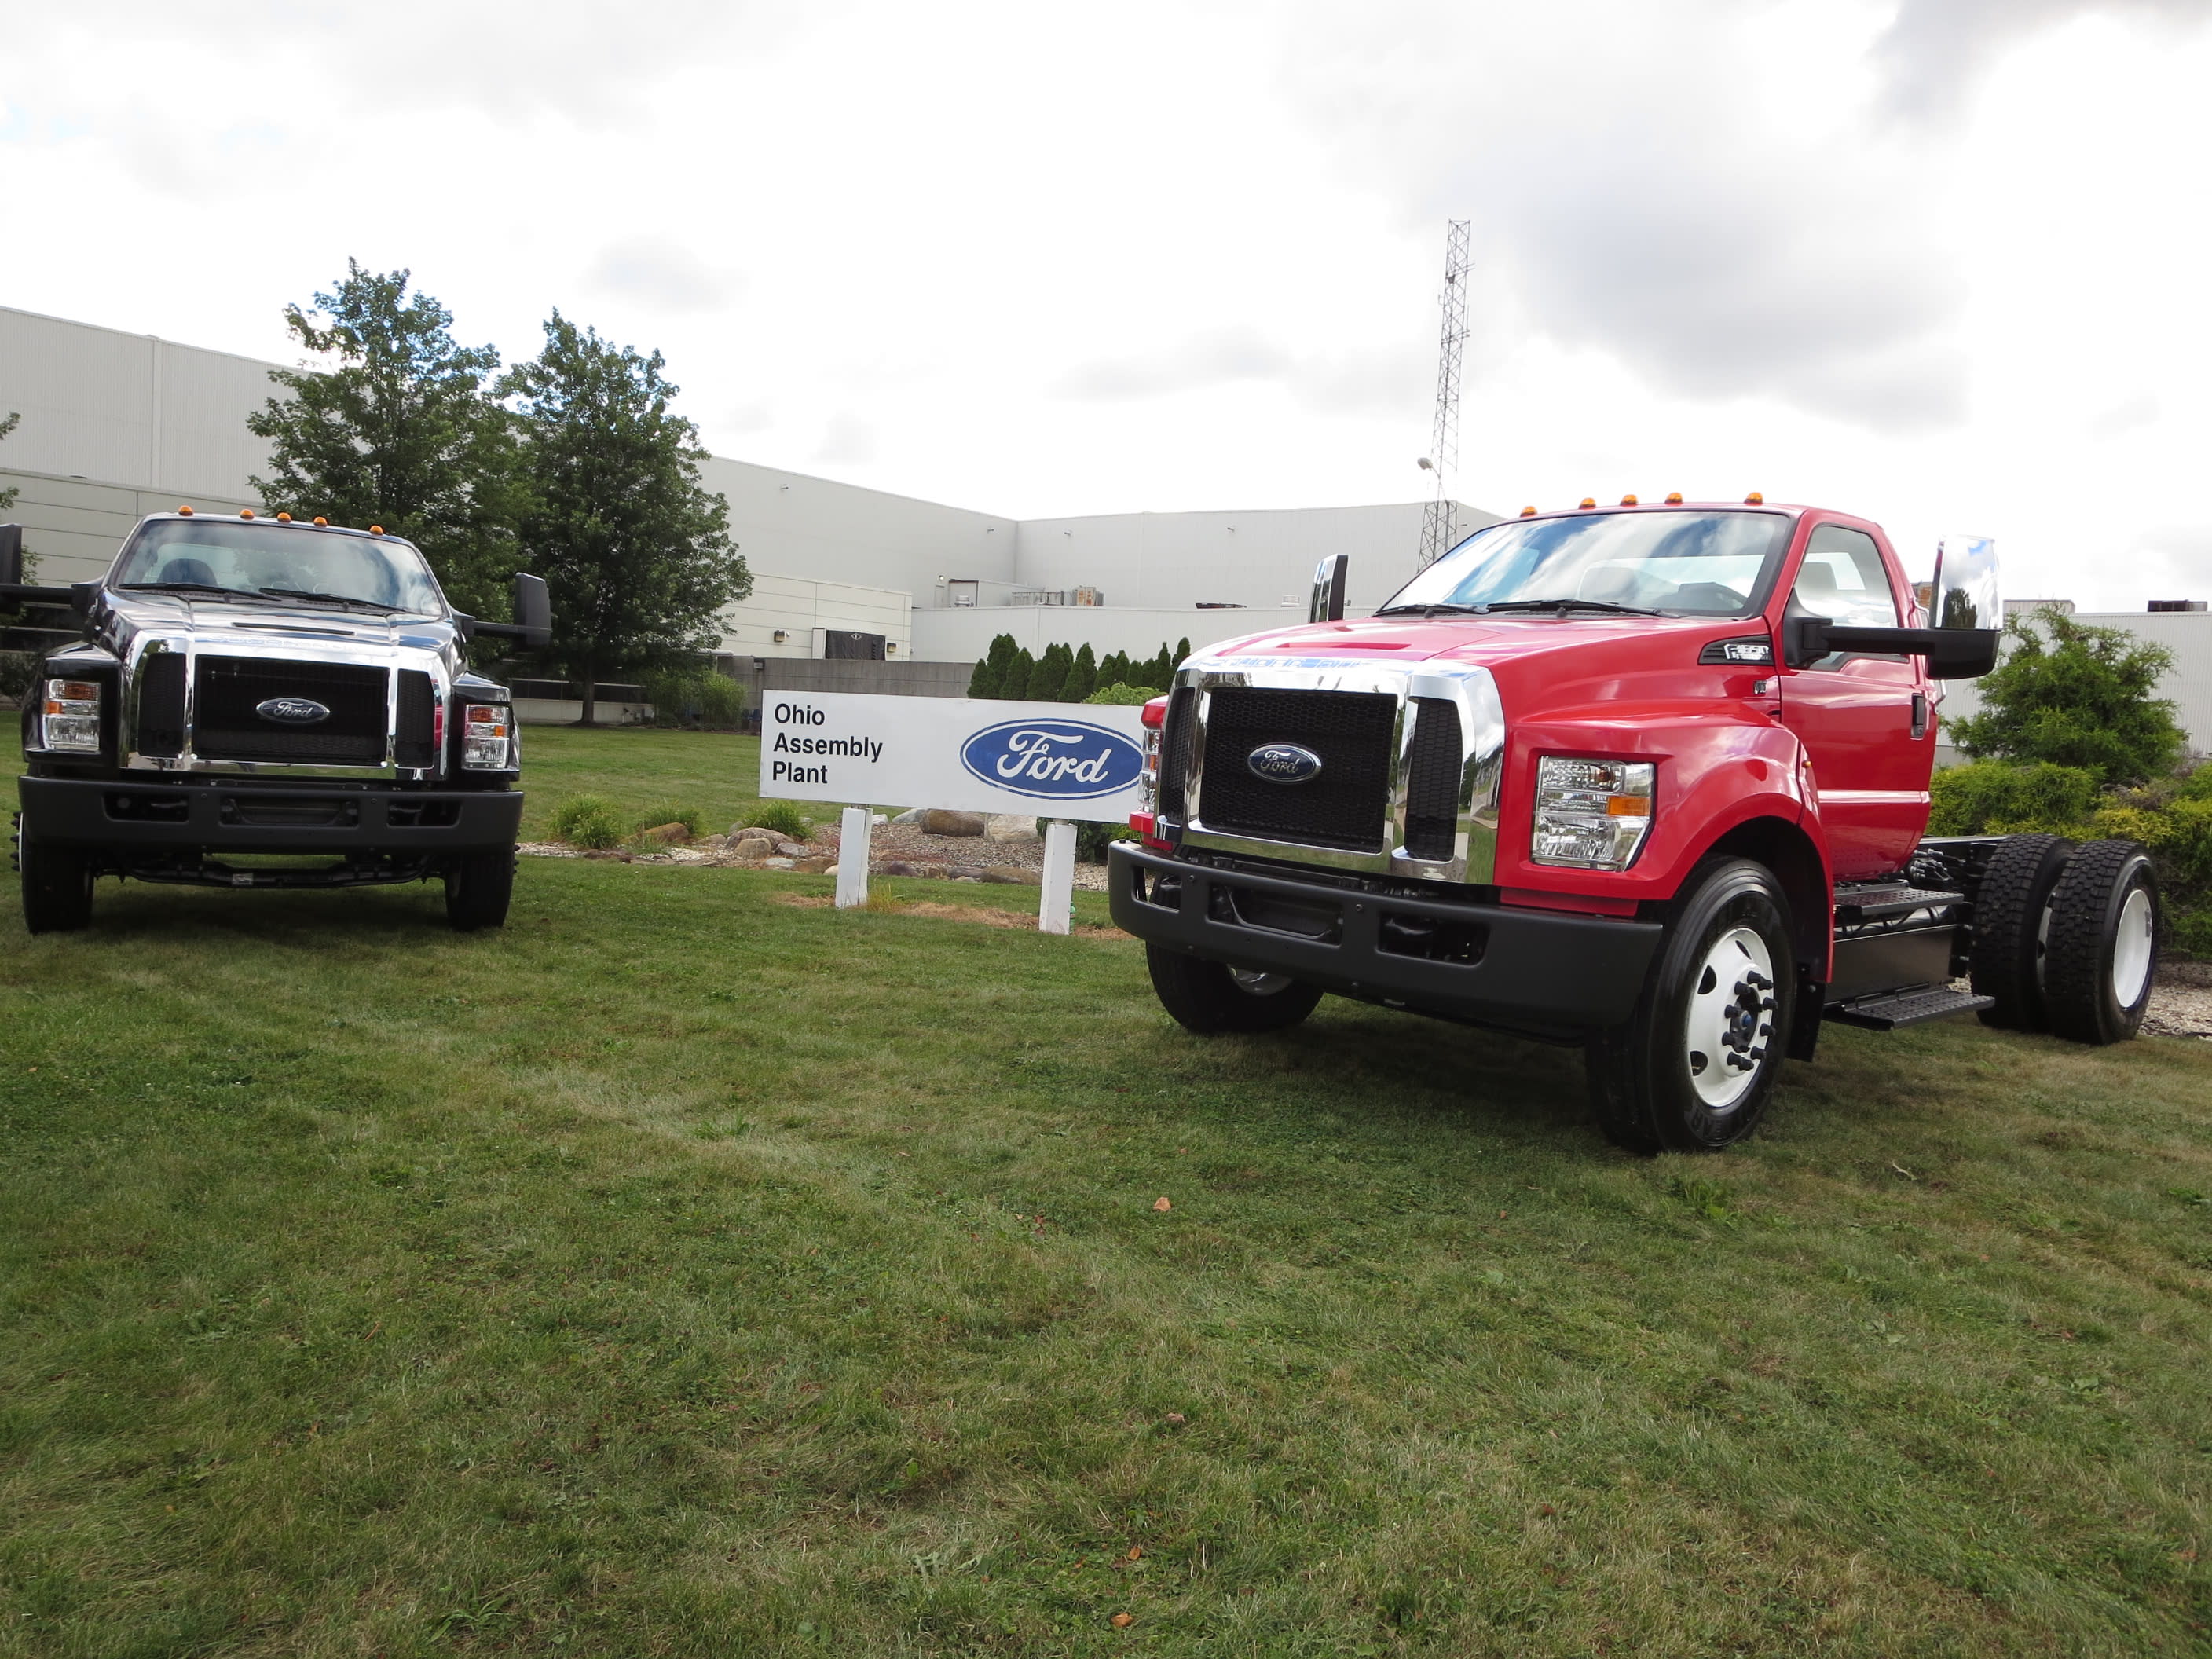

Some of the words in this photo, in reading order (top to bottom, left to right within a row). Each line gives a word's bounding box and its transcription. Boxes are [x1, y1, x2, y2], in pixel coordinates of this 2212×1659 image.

[274, 701, 313, 717] Ford
[775, 703, 825, 726] Ohio
[773, 732, 883, 763] Assembly
[996, 730, 1112, 783] Ford
[772, 760, 828, 784] Plant
[1260, 750, 1300, 773] Ford
